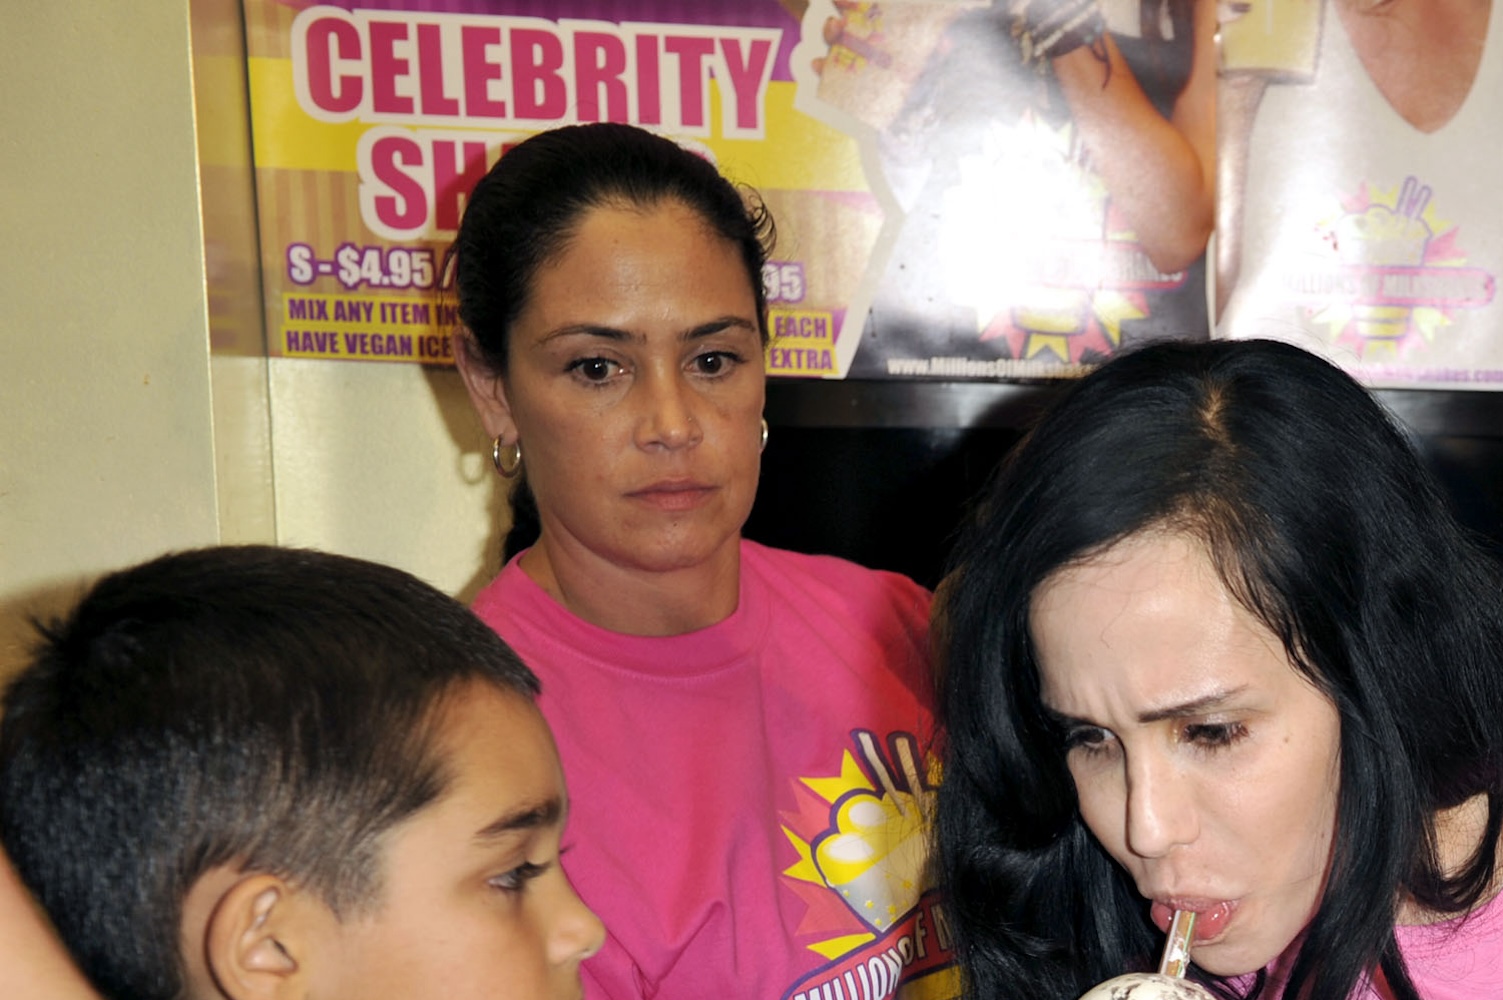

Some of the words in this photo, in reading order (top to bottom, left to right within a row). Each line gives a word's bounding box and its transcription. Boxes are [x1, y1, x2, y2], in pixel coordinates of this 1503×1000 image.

[304, 16, 777, 129] CELEBRITY
[289, 245, 313, 283] S
[337, 245, 434, 288] $4.95
[288, 298, 328, 322] MIX
[334, 300, 374, 323] ANY
[379, 302, 430, 326] ITEM
[774, 316, 827, 338] EACH
[286, 330, 339, 354] HAVE
[344, 332, 413, 356] VEGAN
[418, 335, 451, 358] ICE
[770, 348, 833, 370] EXTRA
